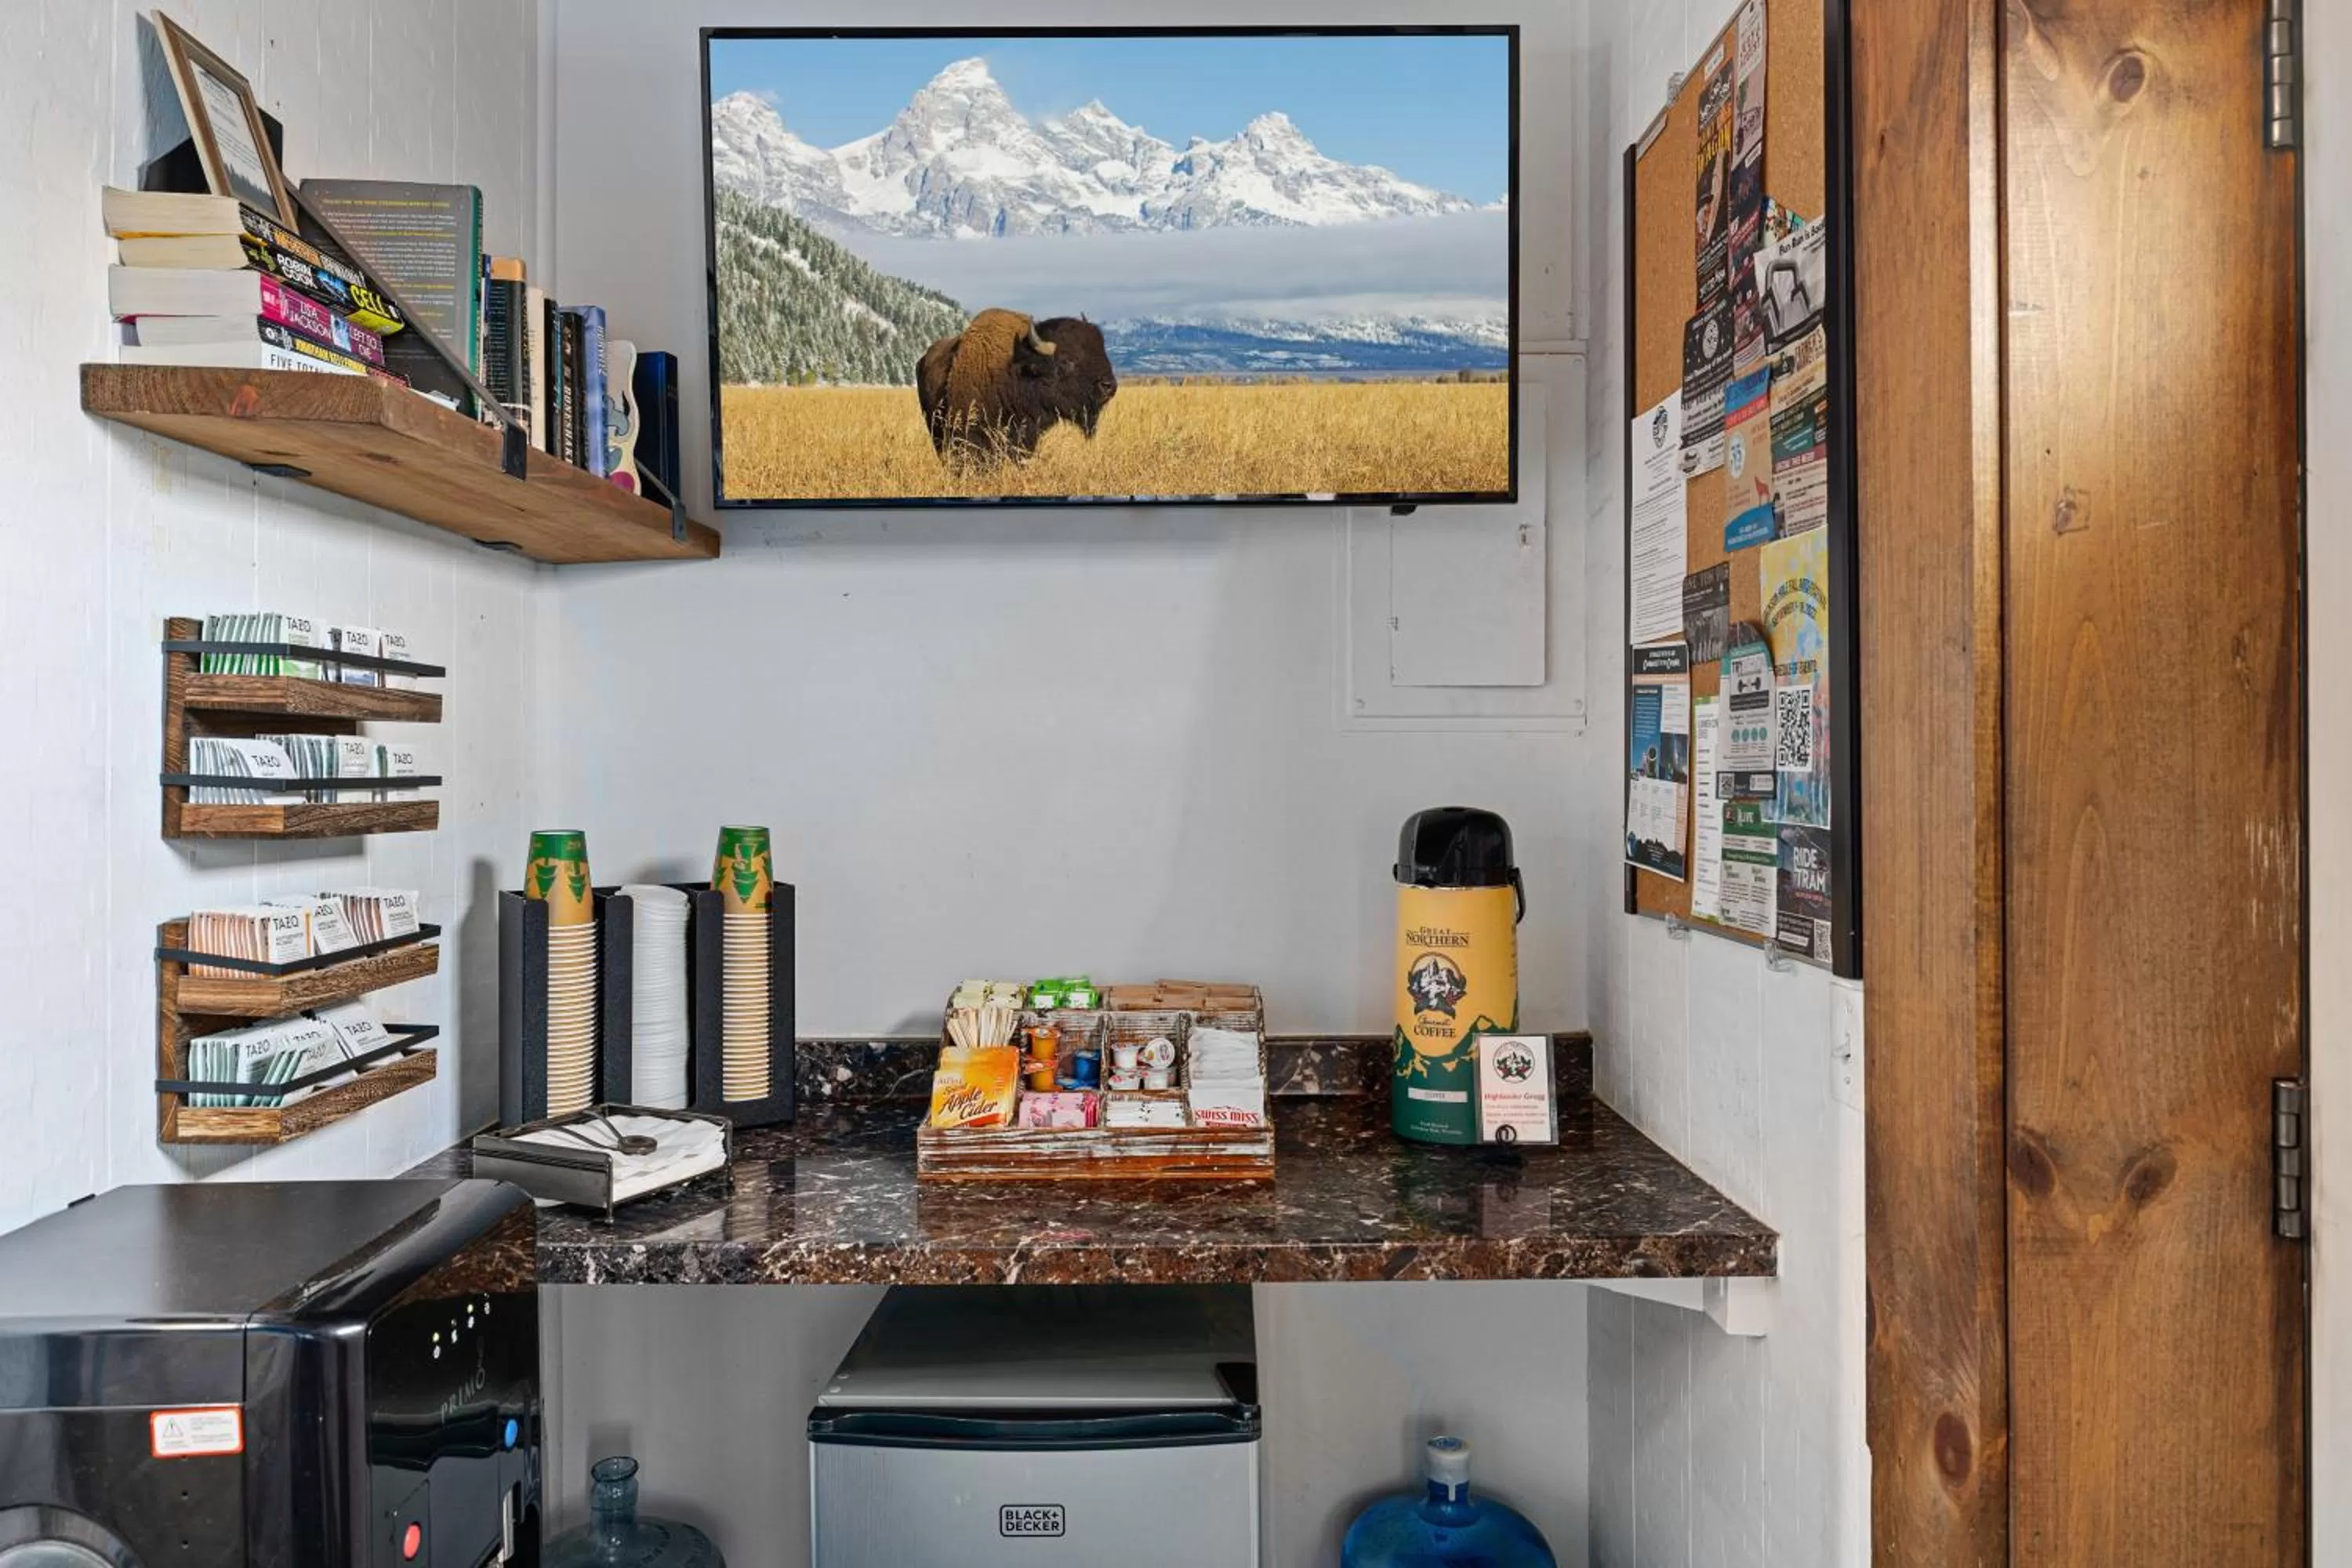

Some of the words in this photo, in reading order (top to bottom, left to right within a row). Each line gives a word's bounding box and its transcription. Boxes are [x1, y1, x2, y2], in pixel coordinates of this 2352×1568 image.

[277, 253, 313, 274] ROBIN
[282, 267, 318, 290] COOK
[350, 284, 391, 319] CELL
[300, 301, 319, 321] LISA
[291, 312, 332, 340] JACKSON
[270, 354, 292, 370] FIVE
[286, 616, 311, 633] TAZO
[346, 630, 369, 646] TAZO
[385, 633, 405, 648] TAZO
[344, 742, 365, 755] TAZO
[250, 754, 281, 768] TAZO
[393, 752, 413, 765] TAZO
[1793, 846, 1818, 869] RIDE
[1793, 868, 1827, 893] TRAM
[383, 895, 406, 909] TAZO
[273, 915, 299, 931] TAZO
[1420, 925, 1451, 935] GREAT
[1406, 931, 1469, 947] NORTHERN
[344, 1022, 372, 1036] TAZO
[1414, 1025, 1457, 1039] COFFEE
[245, 1039, 270, 1058] TAZO
[938, 1086, 982, 1115] Apple
[960, 1099, 998, 1120] Cider
[1194, 1109, 1228, 1121] SWISS
[1229, 1112, 1259, 1123] MISS
[440, 1367, 485, 1424] PRIMO
[1006, 1510, 1059, 1520] BLACK+
[1006, 1521, 1059, 1531] DECKER
